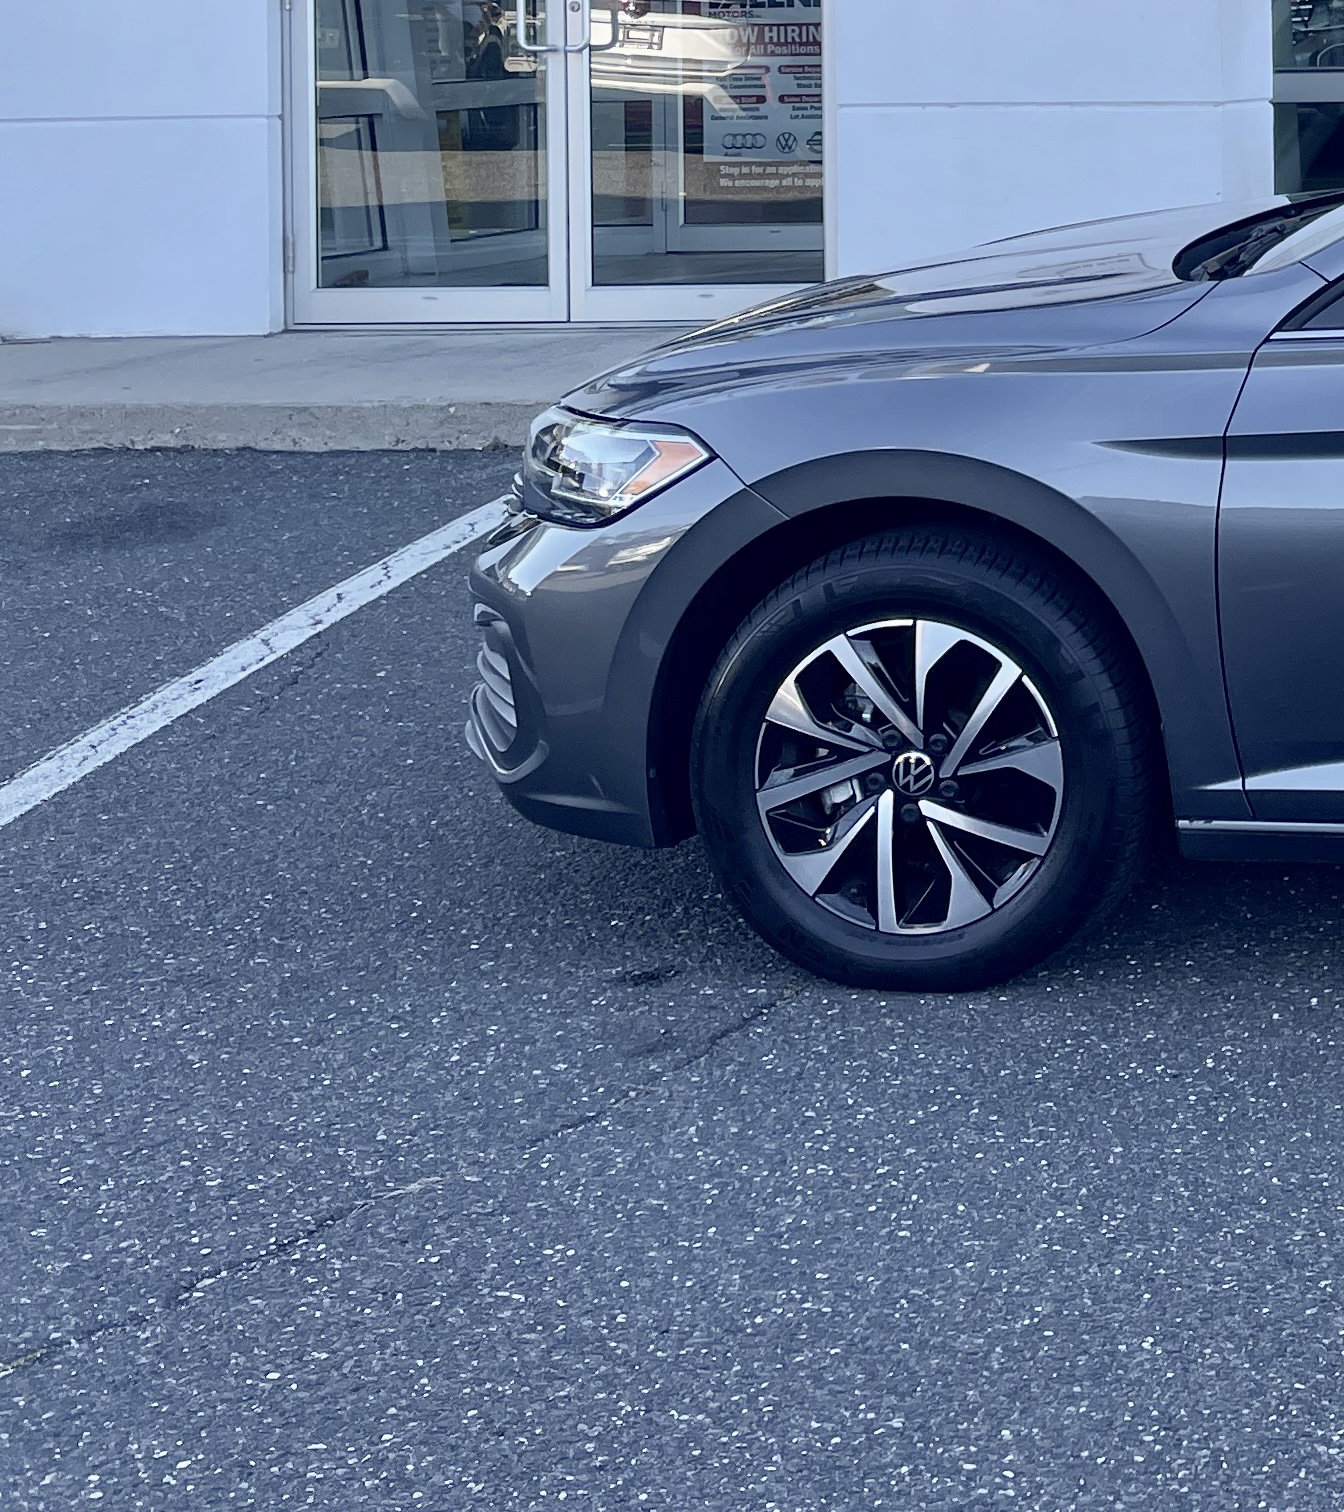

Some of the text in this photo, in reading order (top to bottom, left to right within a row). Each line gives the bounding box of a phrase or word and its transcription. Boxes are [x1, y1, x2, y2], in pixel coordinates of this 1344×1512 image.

[708, 10, 754, 19] MOTORS
[764, 25, 821, 43] HIRIN
[749, 44, 764, 54] All
[767, 44, 820, 54] Positions
